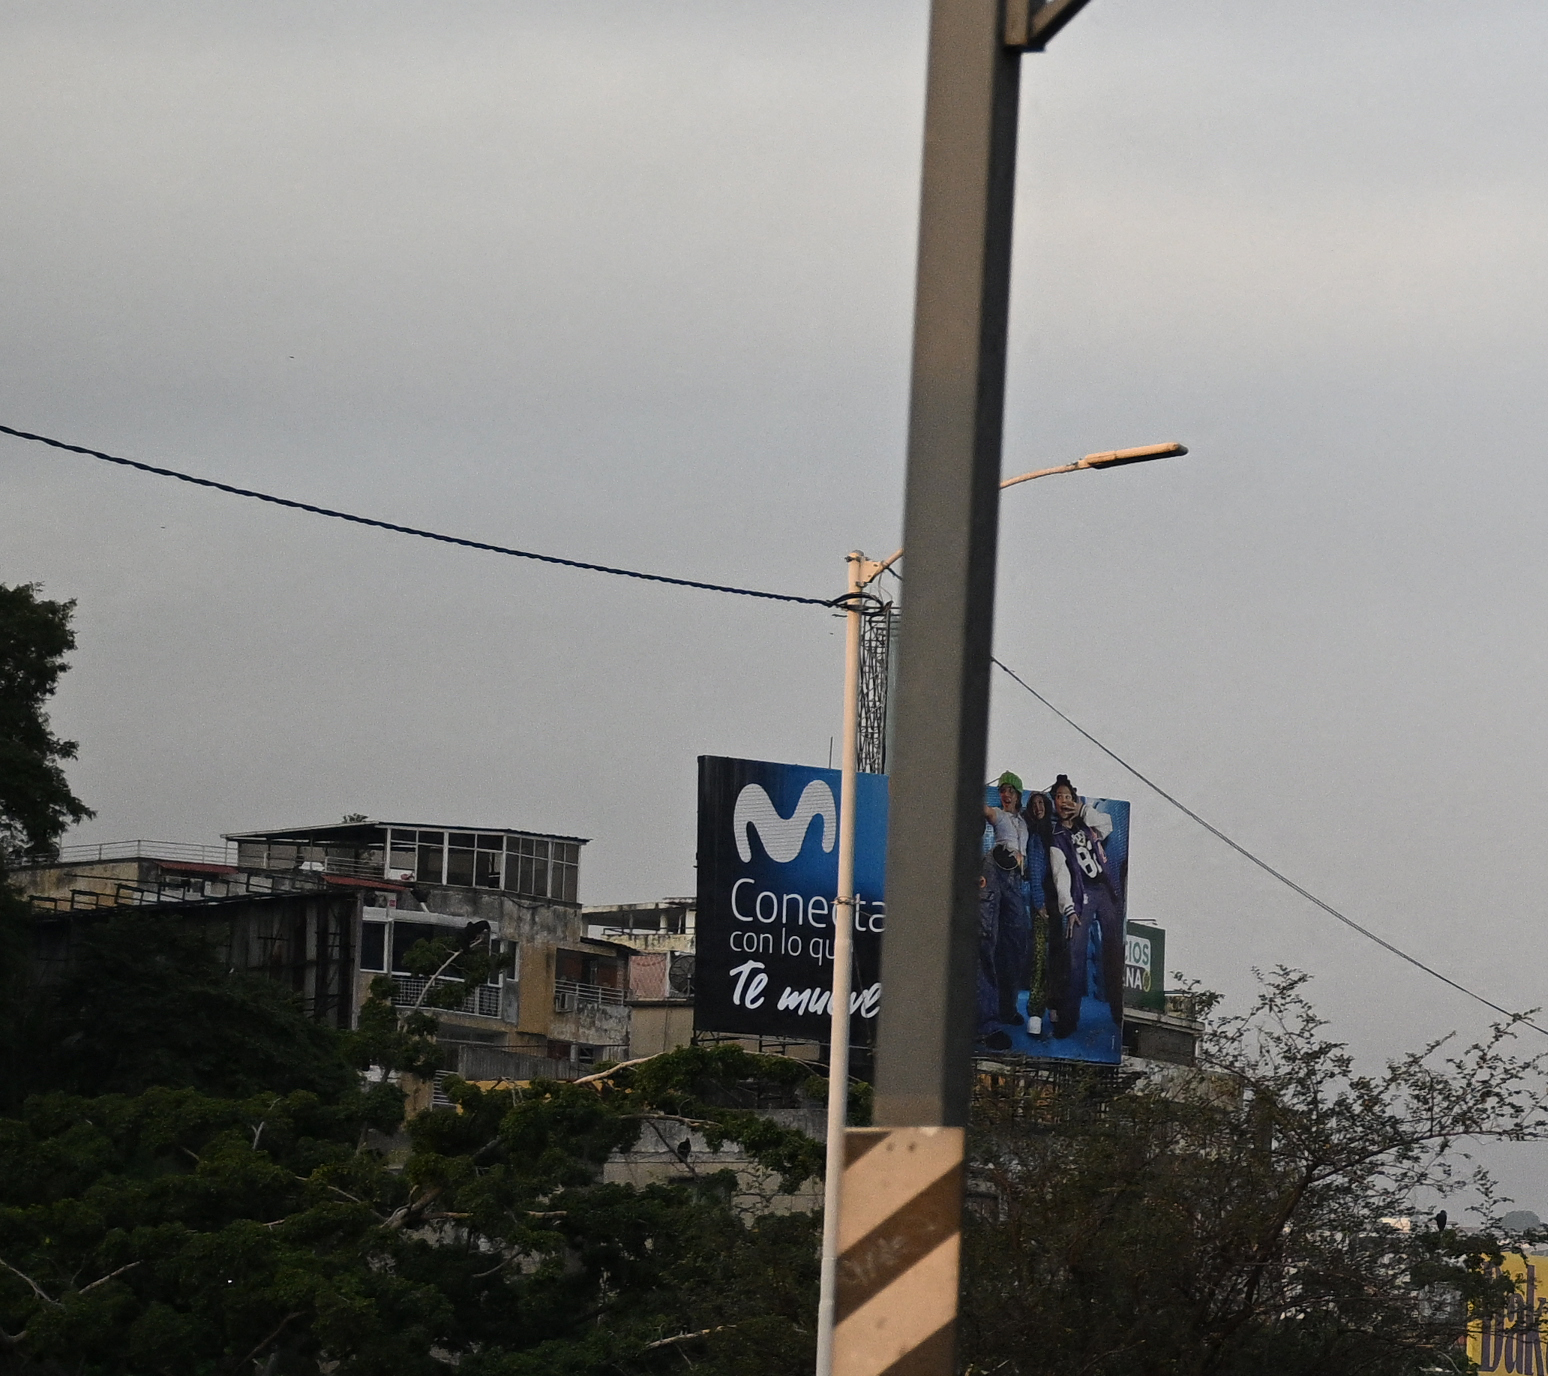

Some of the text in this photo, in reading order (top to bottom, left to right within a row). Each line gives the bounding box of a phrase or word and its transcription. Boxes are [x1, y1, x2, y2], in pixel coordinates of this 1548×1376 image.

[730, 877, 886, 933] Coneta
[729, 928, 803, 955] con lo
[729, 959, 882, 1020] Te muve
